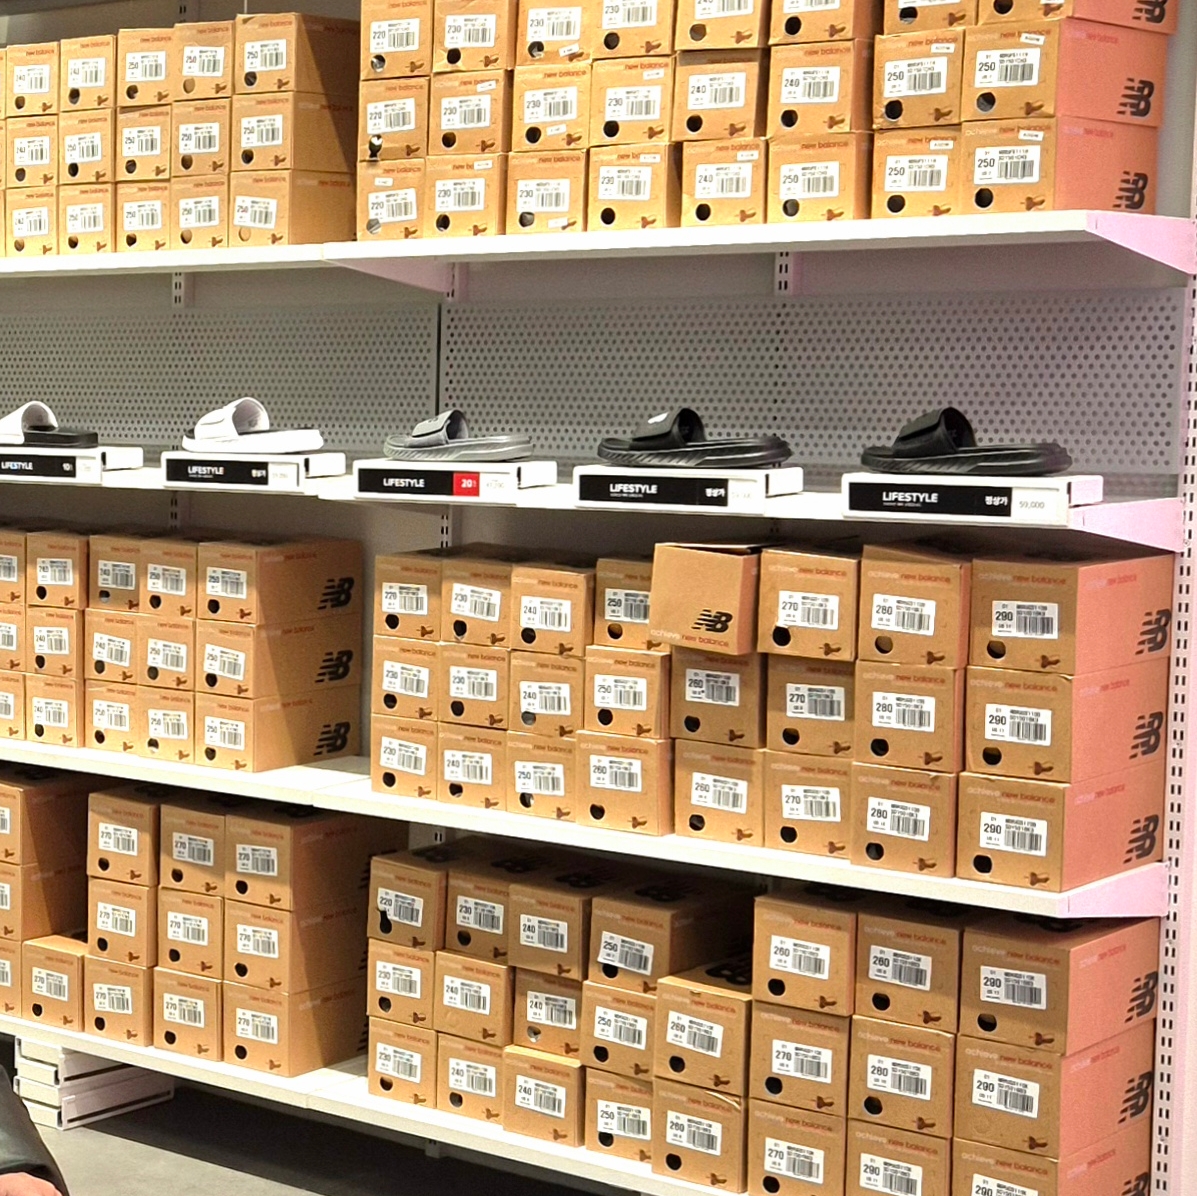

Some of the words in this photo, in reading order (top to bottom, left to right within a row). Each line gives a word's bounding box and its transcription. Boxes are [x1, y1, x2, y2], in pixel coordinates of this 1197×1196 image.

[978, 61, 996, 72] 250
[887, 71, 904, 81] 250
[784, 78, 800, 88] 240
[977, 158, 995, 168] 250
[887, 166, 905, 176] 250
[782, 174, 799, 184] 250
[188, 465, 224, 475] LIFESTYLE
[383, 478, 425, 488] LIFESTYLE
[609, 484, 658, 494] LIFESTYLE
[882, 491, 938, 503] LIFESTYLE
[454, 593, 467, 603] 230
[607, 598, 622, 608] 250
[523, 605, 537, 615] 240
[781, 601, 799, 612] 270
[876, 605, 893, 616] 280
[995, 610, 1014, 622] 290
[597, 685, 612, 694] 250
[522, 691, 537, 701] 240
[789, 693, 806, 704] 270
[876, 703, 893, 714] 280
[988, 714, 1007, 726] 290
[446, 759, 460, 768] 240
[518, 771, 532, 780] 250
[785, 795, 801, 805] 270
[870, 808, 888, 819] 280
[983, 824, 1002, 835] 290
[379, 897, 393, 907] 220
[459, 904, 472, 915] 230
[522, 924, 536, 934] 240
[603, 941, 619, 951] 250
[773, 946, 791, 958] 260
[445, 985, 459, 996] 240
[529, 1000, 543, 1010] 240
[597, 1017, 612, 1027] 250
[670, 1021, 686, 1032] 260
[775, 1051, 792, 1061] 270
[451, 1068, 464, 1078] 240
[518, 1085, 532, 1096] 240
[976, 1080, 995, 1092] 290
[600, 1110, 614, 1120] 250
[767, 1149, 784, 1160] 270
[862, 1164, 881, 1175] 290
[975, 1185, 993, 1196] 290
